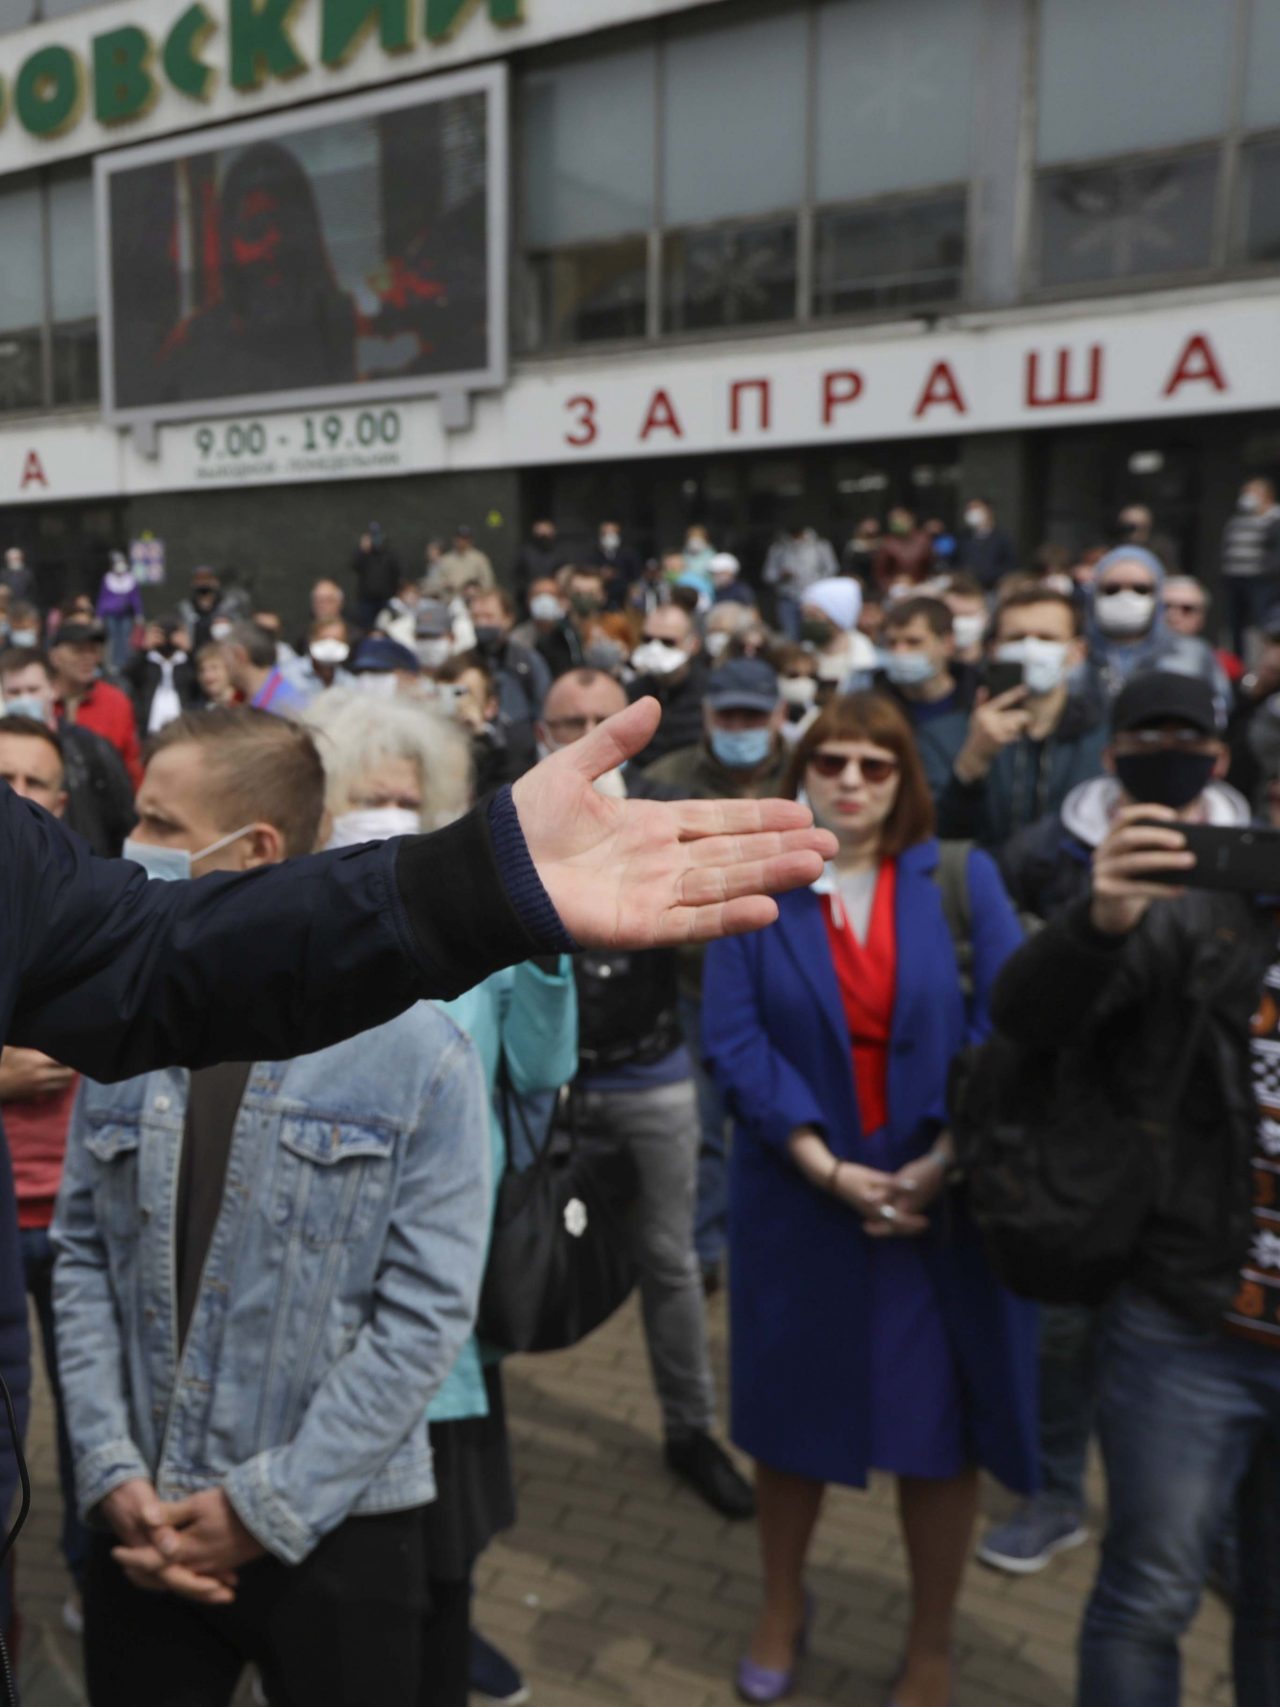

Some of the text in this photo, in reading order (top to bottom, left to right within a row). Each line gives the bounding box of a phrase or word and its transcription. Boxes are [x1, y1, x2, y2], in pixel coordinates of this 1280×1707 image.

[565, 333, 1228, 447] ЗАПРАША
[195, 422, 267, 459] 9.00
[304, 409, 401, 453] 19.00
